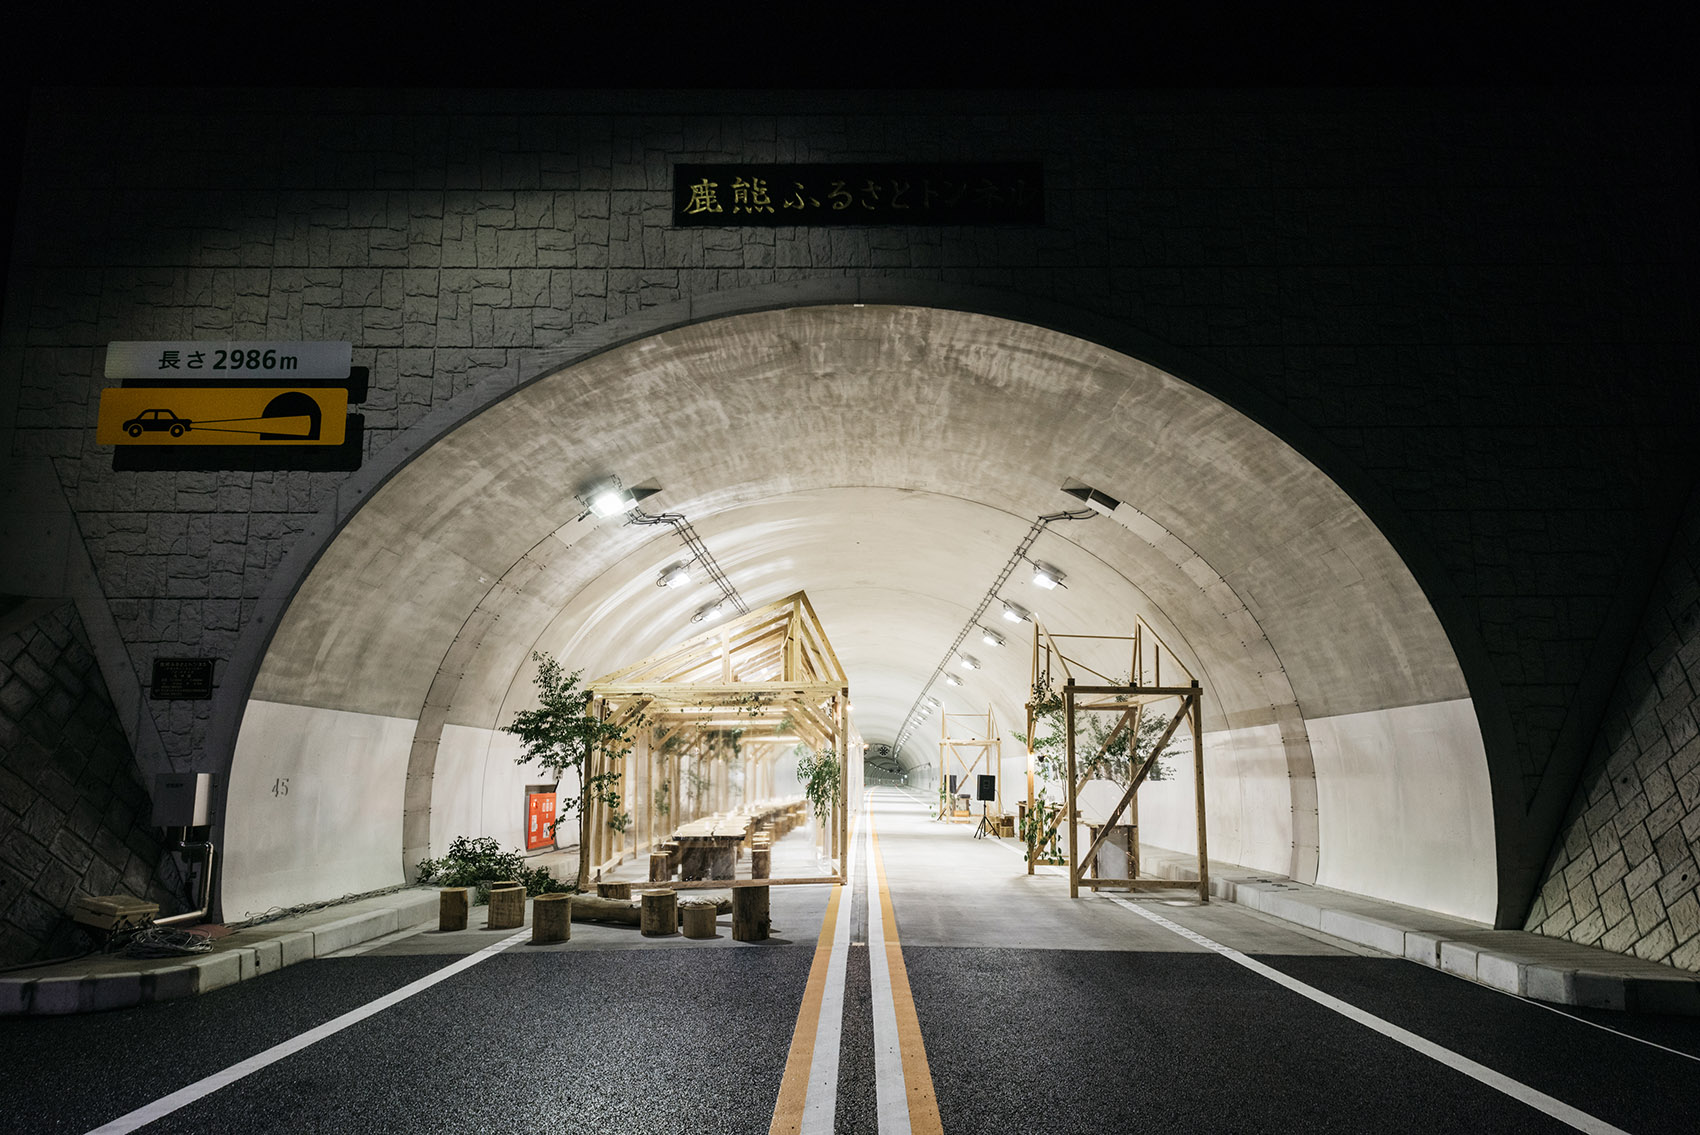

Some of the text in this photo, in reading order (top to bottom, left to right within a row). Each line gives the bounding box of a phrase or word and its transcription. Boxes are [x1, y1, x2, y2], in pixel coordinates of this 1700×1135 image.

[683, 177, 1037, 215] 鹿熊ふるさとトンネル
[271, 777, 290, 798] 45
